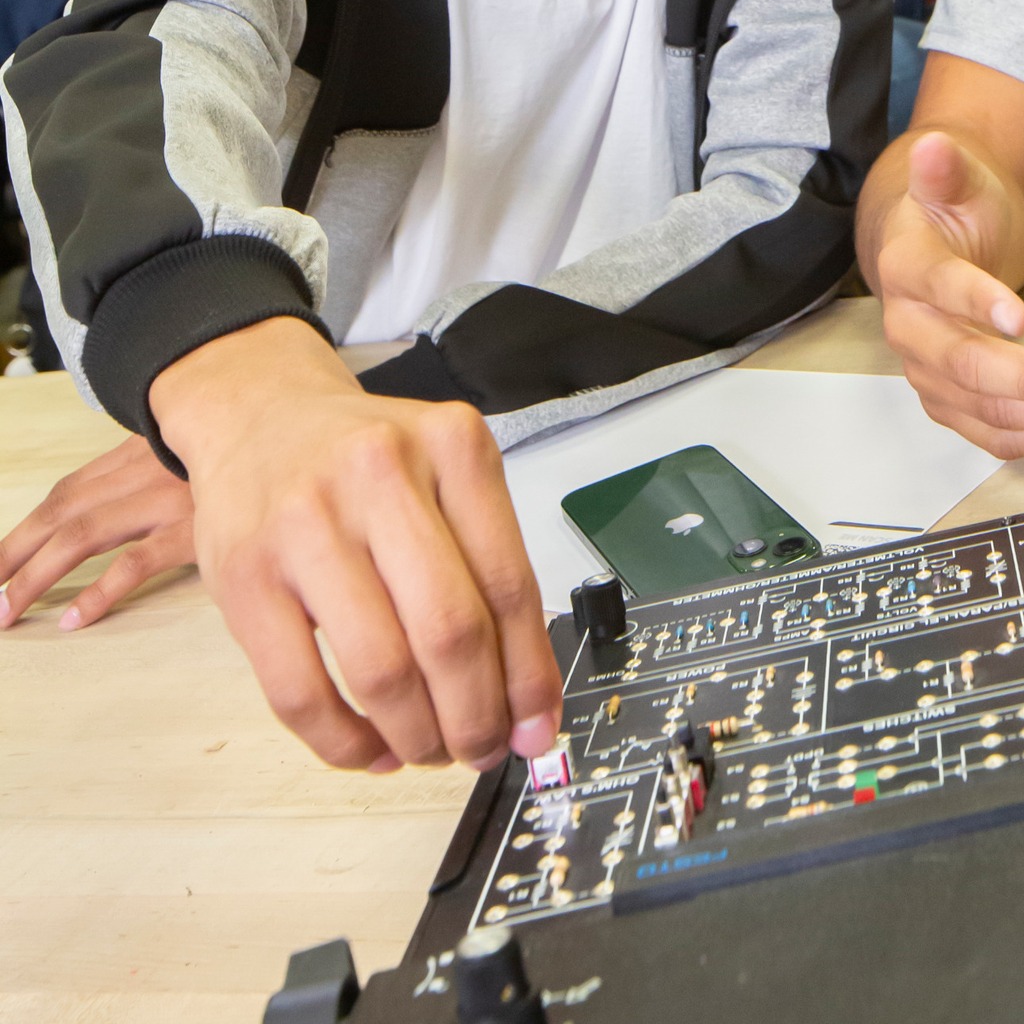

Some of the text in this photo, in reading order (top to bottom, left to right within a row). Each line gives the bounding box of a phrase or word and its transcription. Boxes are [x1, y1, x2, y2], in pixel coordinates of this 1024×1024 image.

[876, 606, 917, 620] VOLTS
[851, 622, 914, 642] CIRCUIT
[666, 663, 726, 681] POWER
[863, 705, 956, 733] SWITCHES
